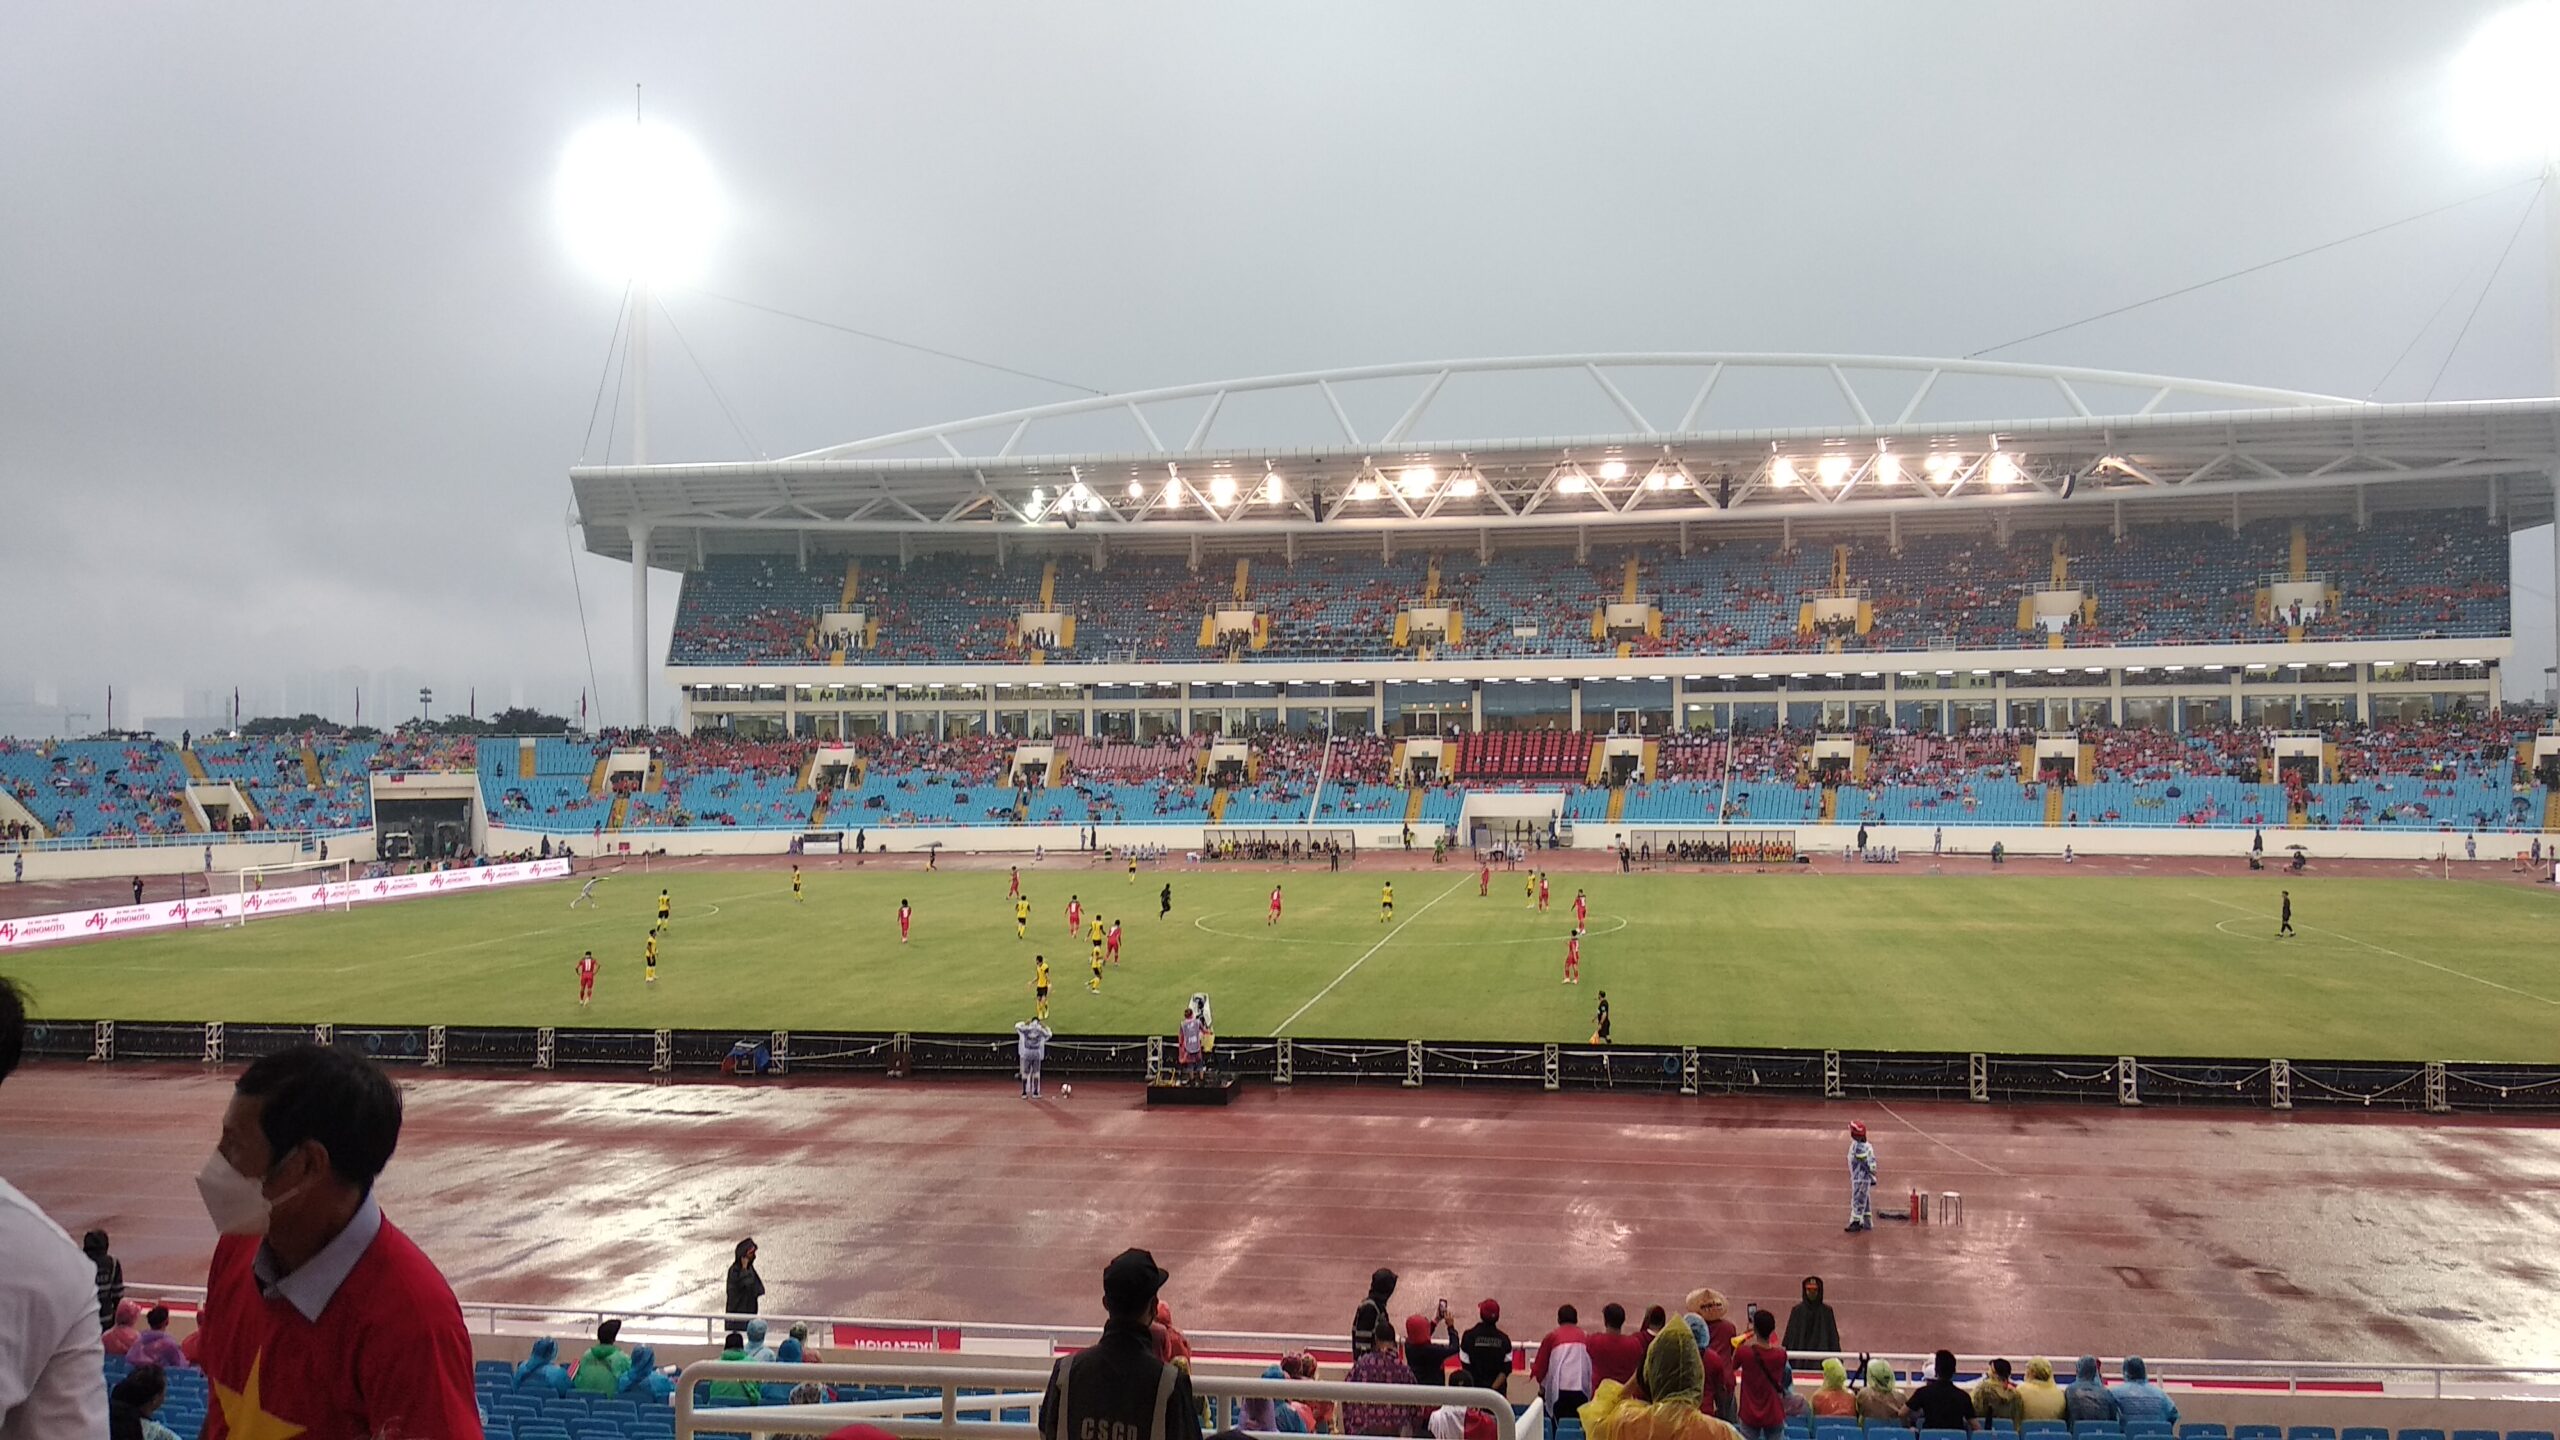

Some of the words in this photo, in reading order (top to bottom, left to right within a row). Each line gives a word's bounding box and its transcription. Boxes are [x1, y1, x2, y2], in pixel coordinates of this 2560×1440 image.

[374, 880, 388, 895] Aj
[244, 894, 262, 910] Aj
[85, 912, 108, 930] Aj
[110, 913, 150, 924] AJINOMOTO
[0, 923, 17, 941] Aj
[21, 924, 65, 936] AJINOMOTO
